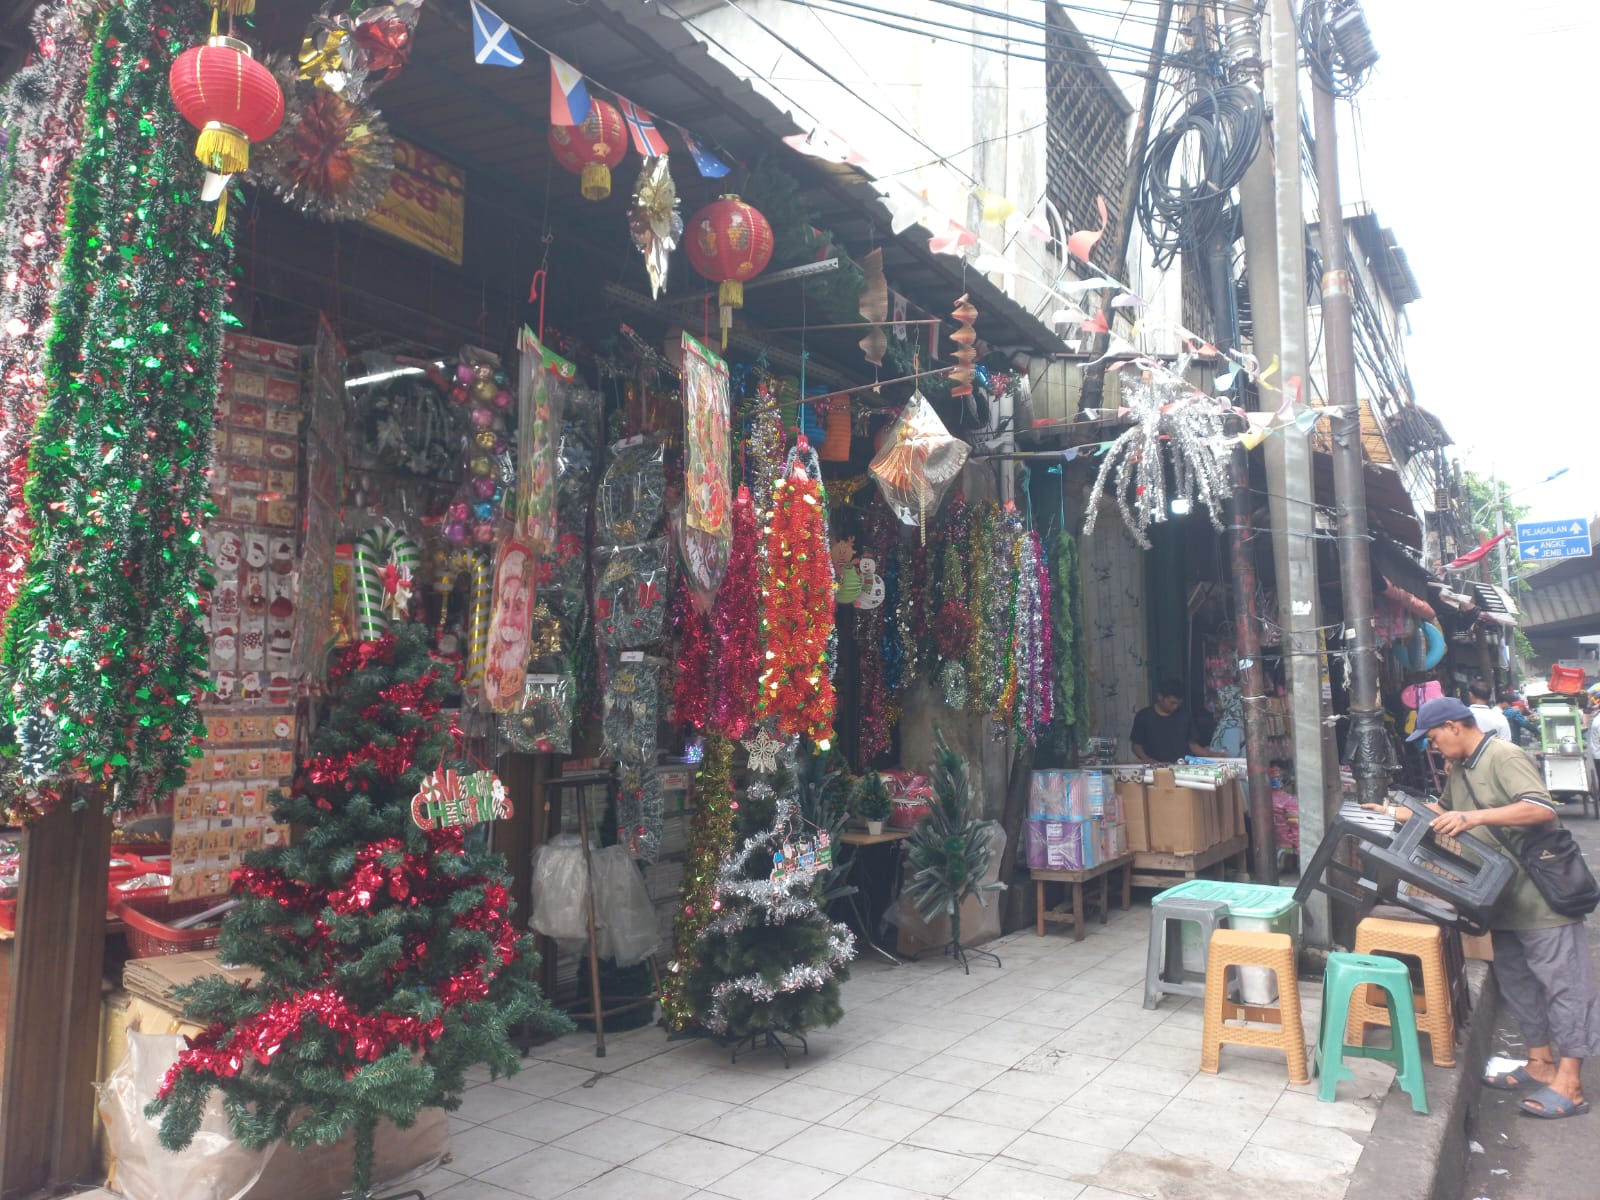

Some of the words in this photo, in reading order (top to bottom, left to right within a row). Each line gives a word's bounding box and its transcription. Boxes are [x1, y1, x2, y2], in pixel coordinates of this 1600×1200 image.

[1522, 525, 1568, 536] PEJAGALAN
[1541, 540, 1566, 549] ANGKE
[1566, 546, 1586, 555] LIMA
